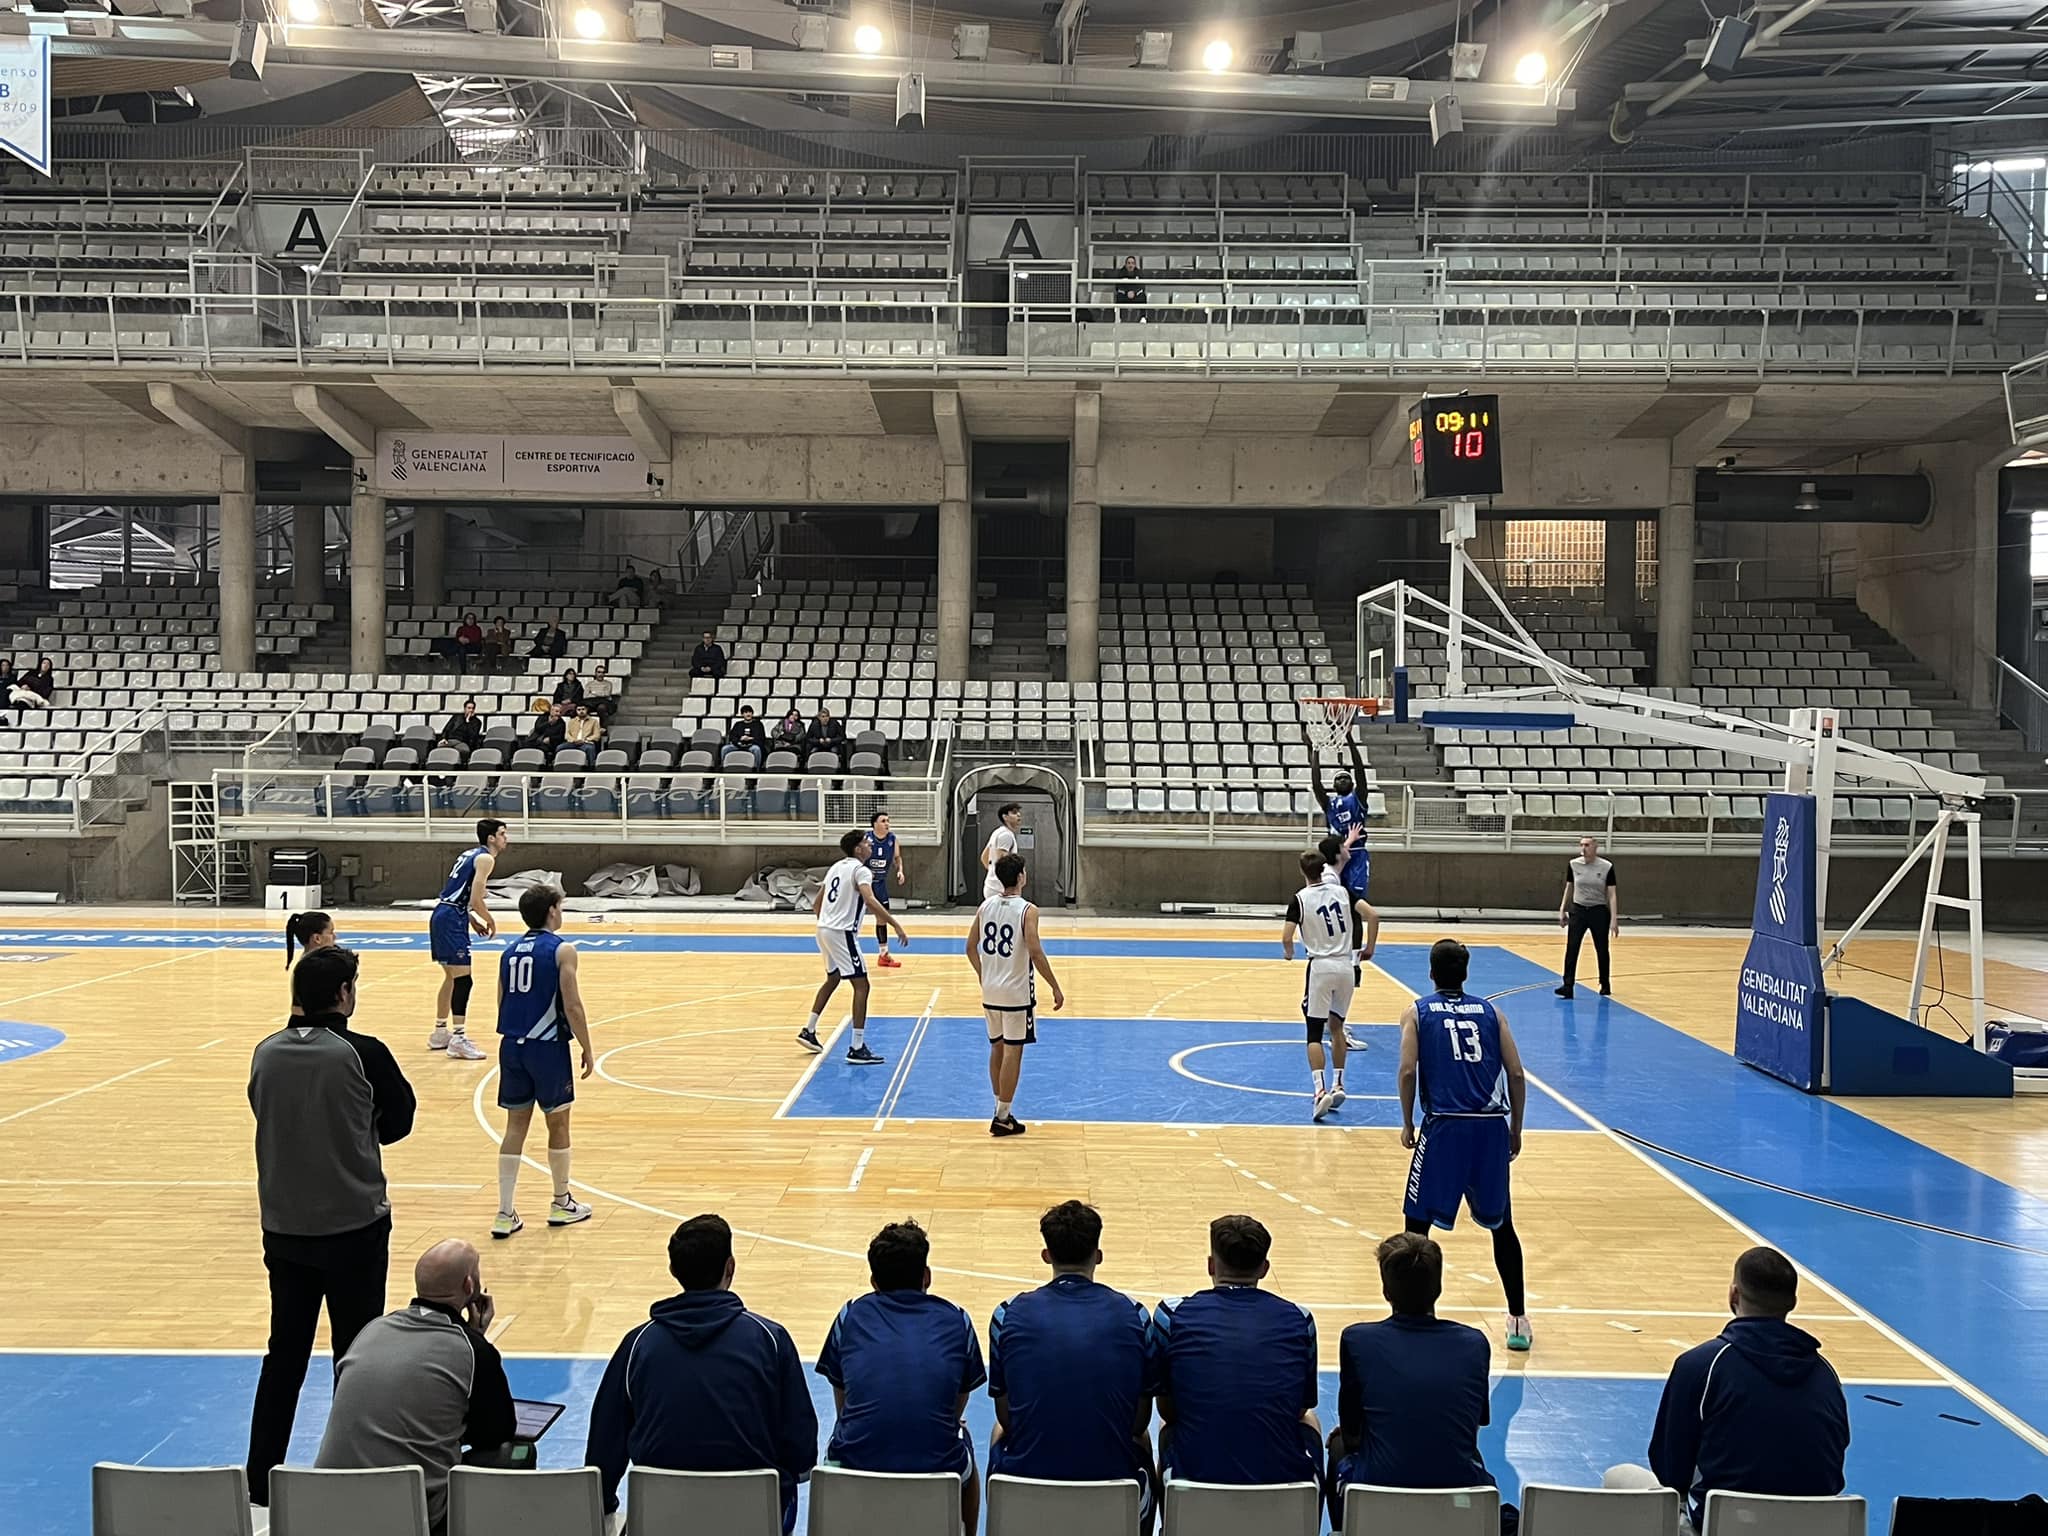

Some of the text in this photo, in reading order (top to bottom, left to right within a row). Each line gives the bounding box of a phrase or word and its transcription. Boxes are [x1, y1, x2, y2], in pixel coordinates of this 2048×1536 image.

[284, 208, 328, 253] A
[1000, 218, 1042, 259] A
[411, 449, 488, 460] GENERALITAT
[515, 451, 635, 462] CENTRE DE TECNIFICACIÓ
[1454, 431, 1483, 457] 10
[412, 461, 487, 472] VALENCIANA
[546, 463, 600, 473] ESPORTIVA
[280, 891, 288, 909] 1
[827, 876, 840, 903] 8
[1316, 901, 1346, 937] 11
[982, 921, 1014, 958] 88
[508, 955, 534, 993] 10
[1743, 967, 1808, 1005] GENERALITAT
[1741, 991, 1804, 1031] VALENCIANA
[1443, 1018, 1483, 1063] 13
